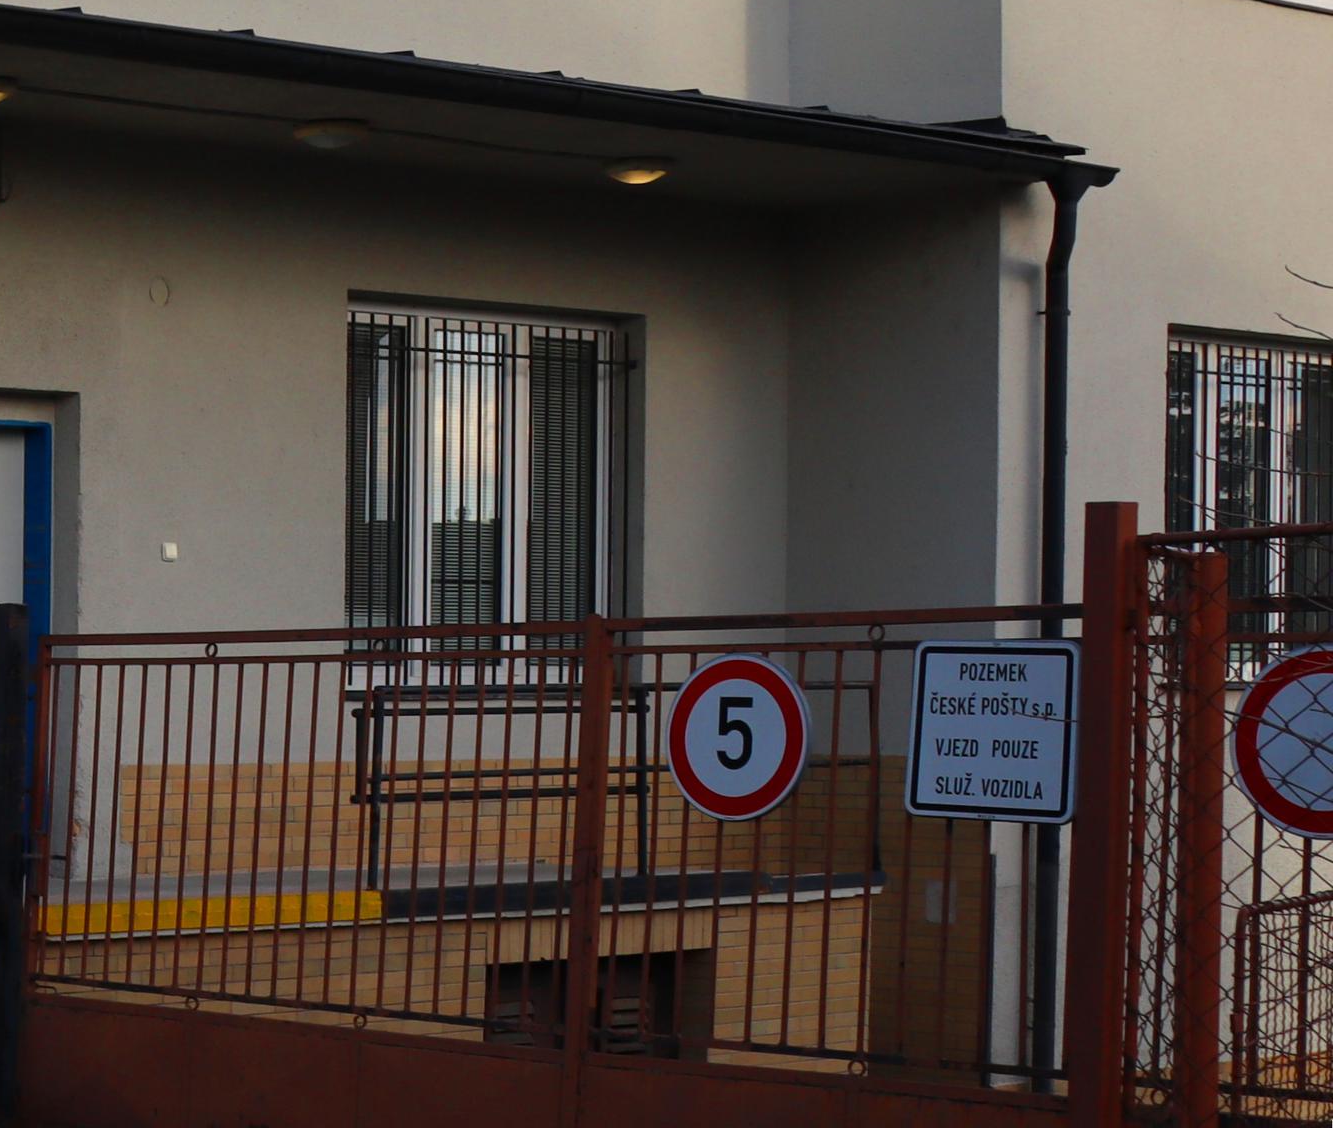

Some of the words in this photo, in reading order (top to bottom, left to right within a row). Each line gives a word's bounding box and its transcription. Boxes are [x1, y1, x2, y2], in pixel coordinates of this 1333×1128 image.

[959, 662, 1028, 682] POZEMEK
[930, 691, 976, 716] ČESKÉ
[981, 692, 1029, 717] POŠTY
[716, 696, 754, 770] 5
[935, 738, 979, 758] VJEZD
[992, 739, 1040, 760] POUZE
[934, 772, 975, 796] SLUŽ.
[981, 778, 1044, 800] VOZIDLA
